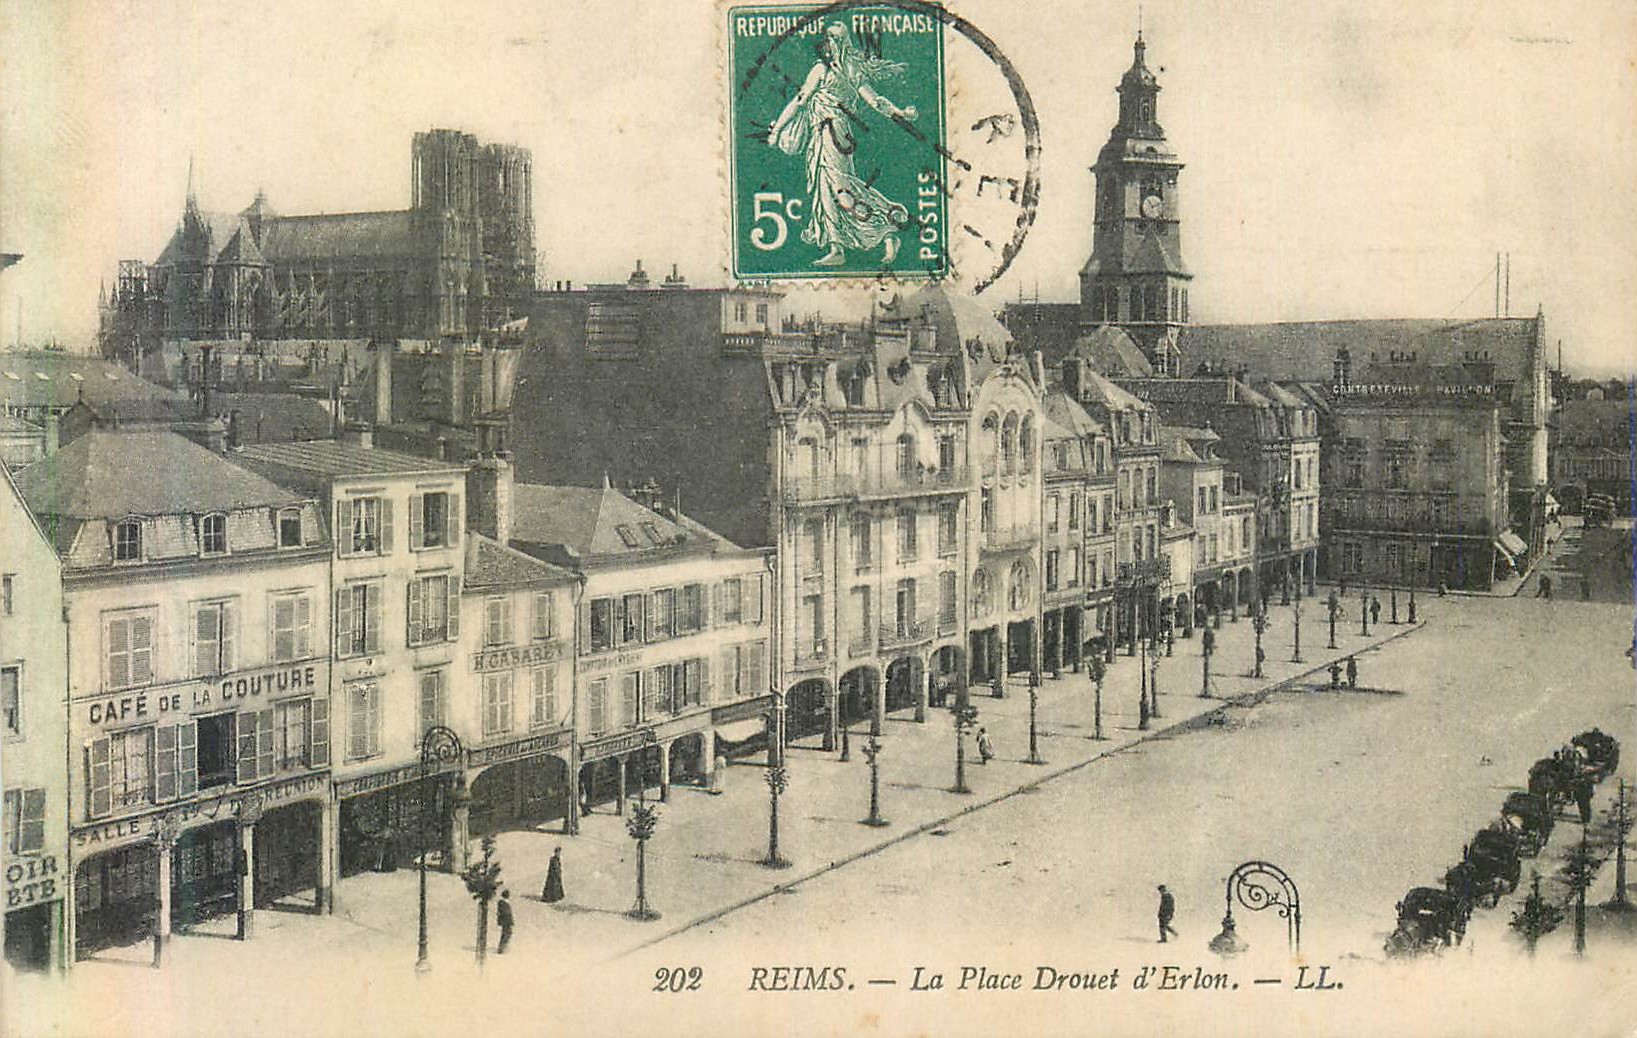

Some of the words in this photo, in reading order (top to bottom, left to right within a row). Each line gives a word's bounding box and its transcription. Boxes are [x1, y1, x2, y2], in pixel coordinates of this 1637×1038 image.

[852, 13, 935, 37] FRANÇAISE
[919, 171, 939, 260] POSTES
[89, 690, 149, 724] CAFÉ
[159, 694, 181, 712] DE
[193, 691, 211, 708] LA
[222, 667, 316, 701] COUTURE
[76, 819, 140, 847] SALLE
